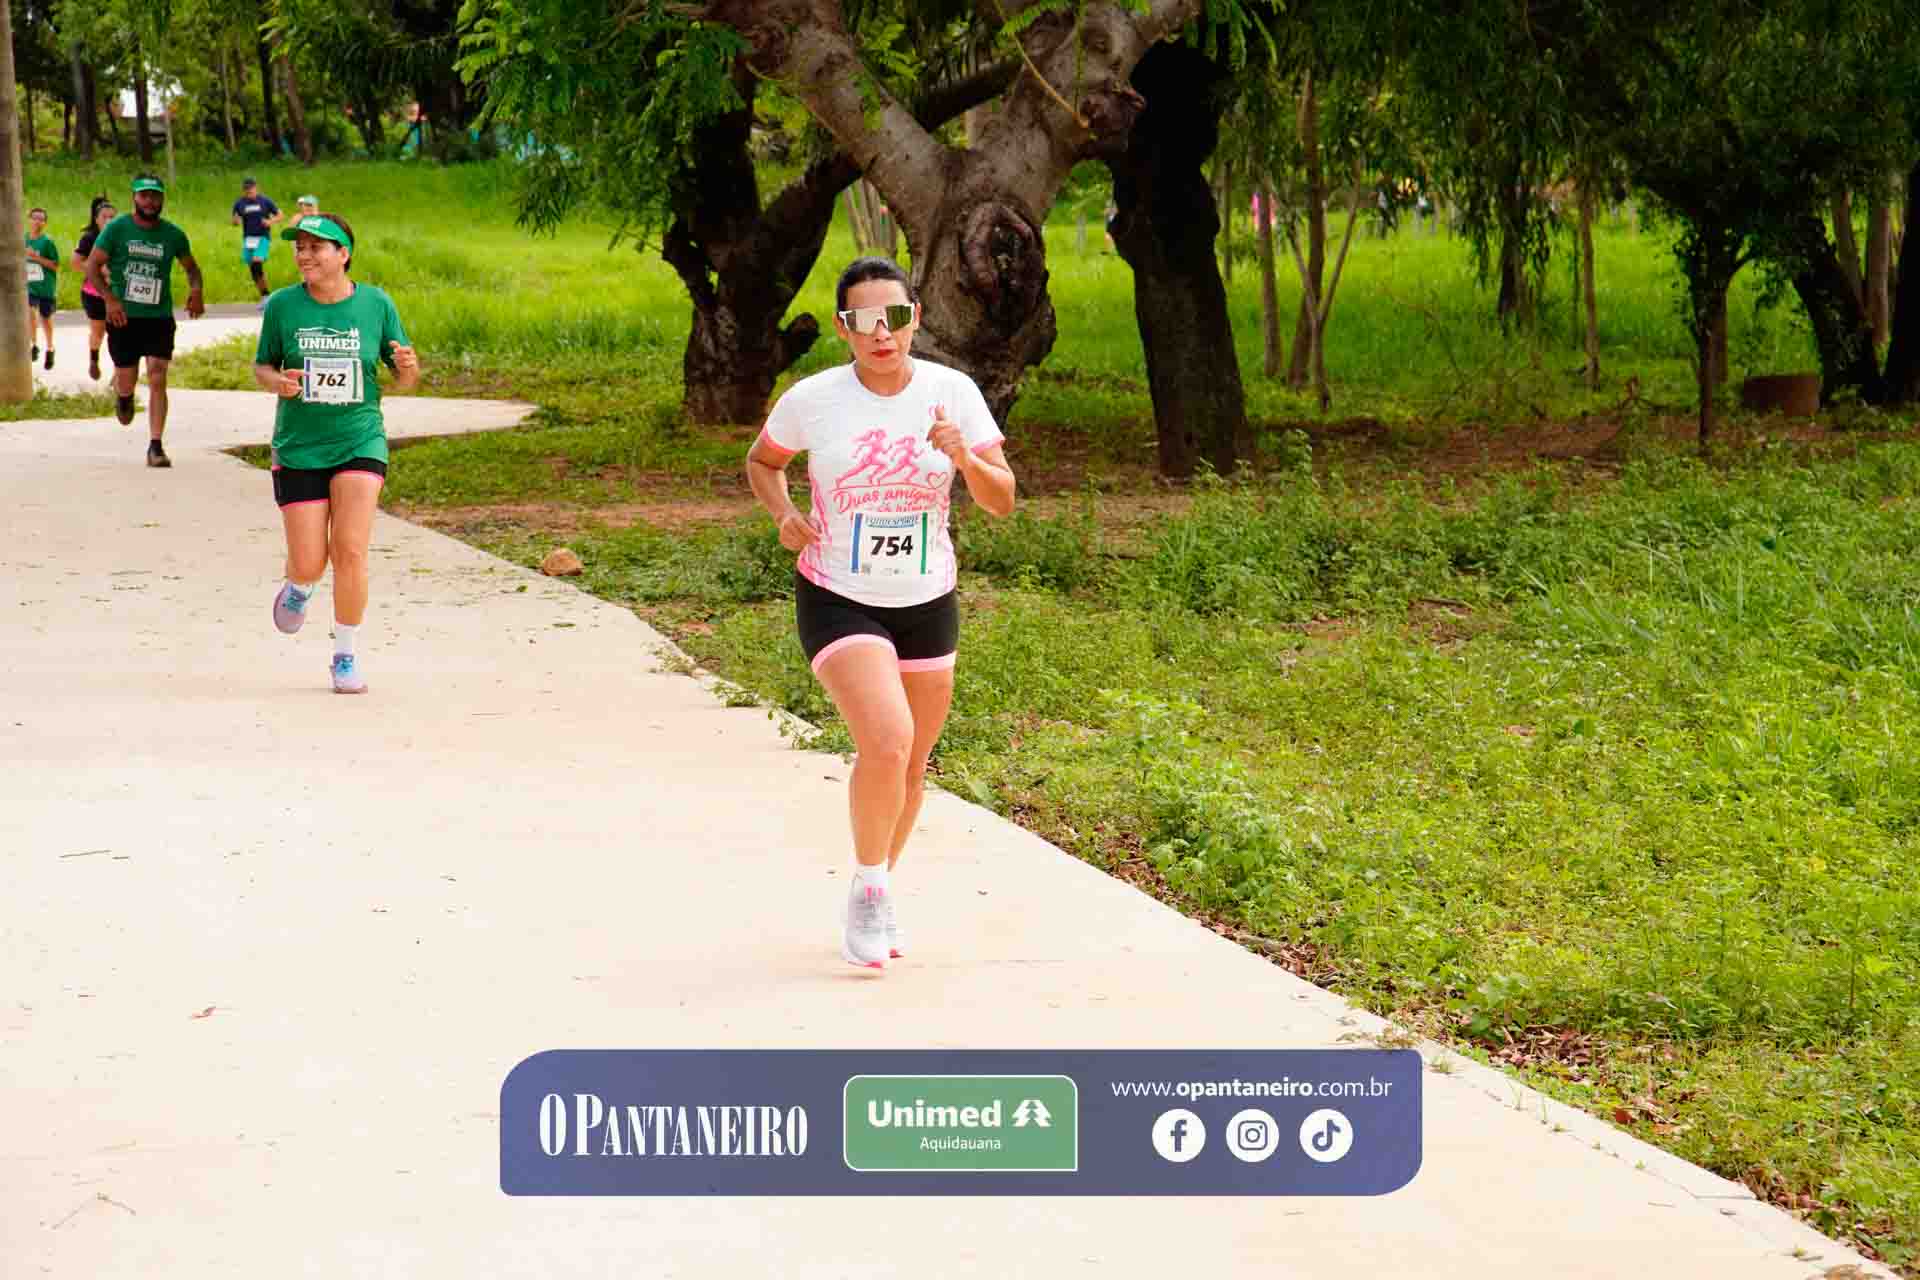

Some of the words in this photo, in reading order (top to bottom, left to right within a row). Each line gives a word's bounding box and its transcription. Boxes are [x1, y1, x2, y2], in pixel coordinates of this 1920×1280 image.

[299, 338, 361, 350] UNIMED
[316, 373, 346, 387] 762
[833, 489, 879, 513] Duas
[870, 535, 913, 556] 754
